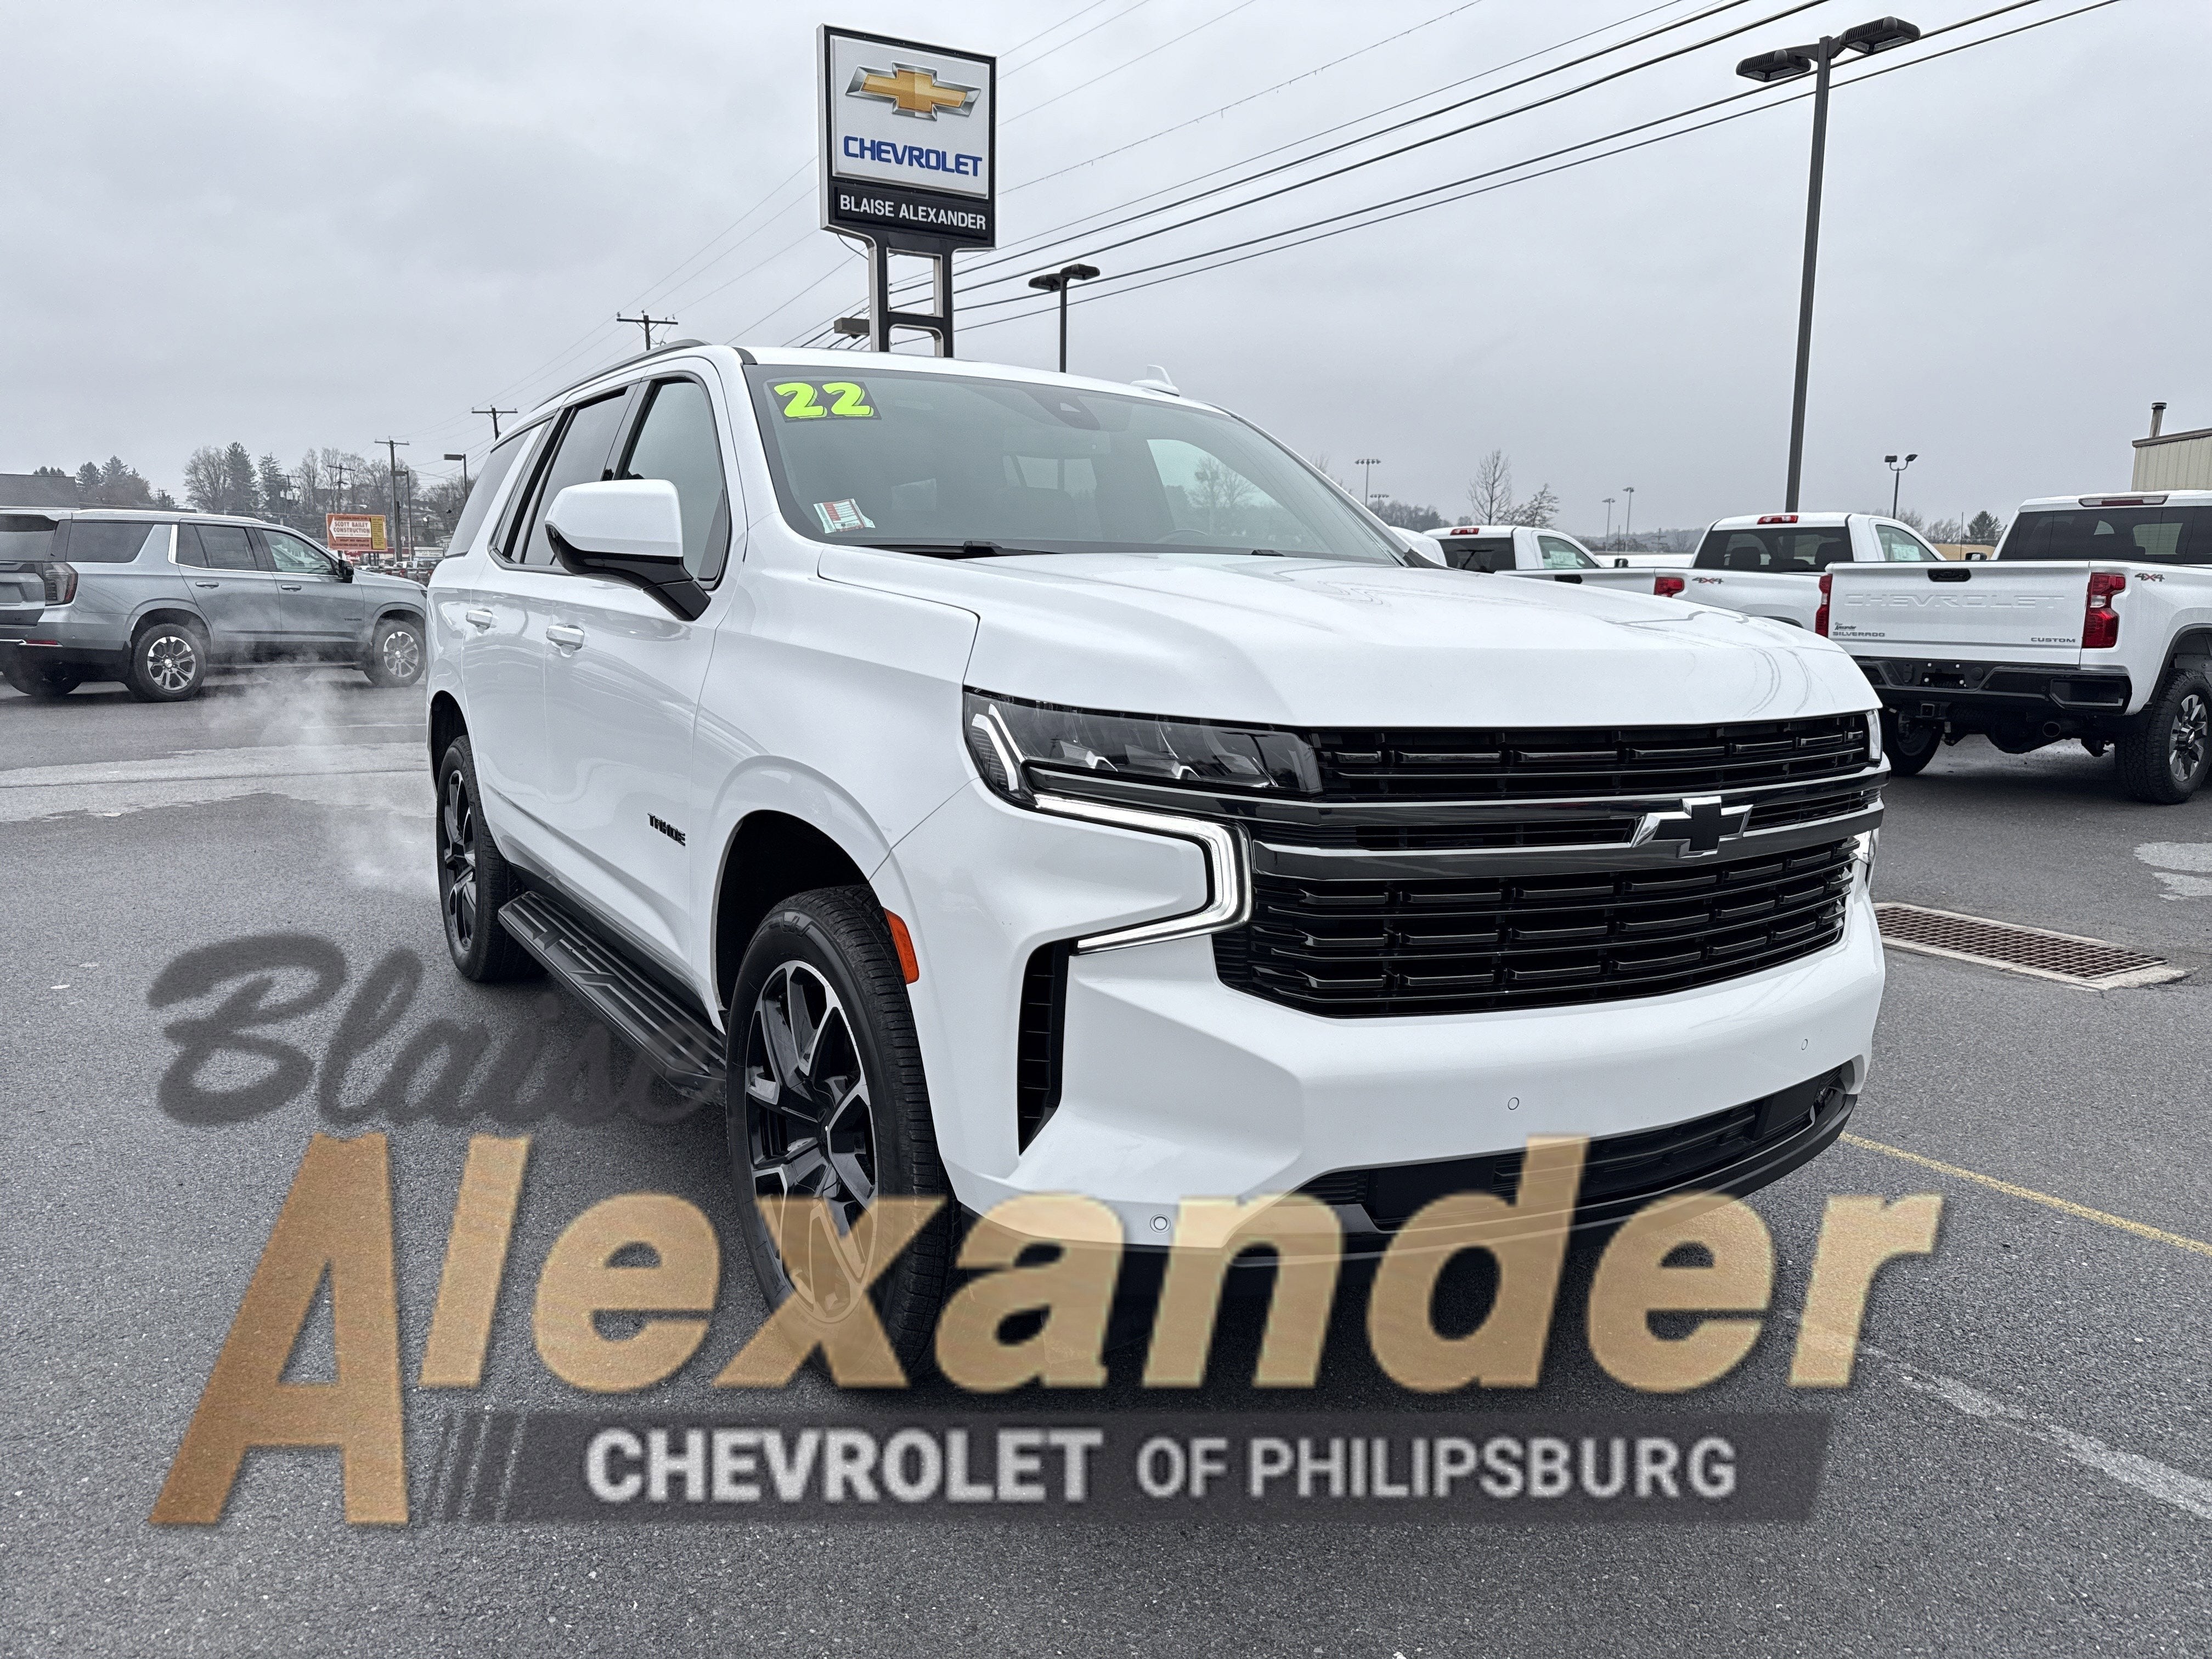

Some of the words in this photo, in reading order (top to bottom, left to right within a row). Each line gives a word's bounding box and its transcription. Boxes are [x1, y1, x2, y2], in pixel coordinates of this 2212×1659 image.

[843, 136, 983, 177] CHEVROLET
[840, 194, 895, 217] BLAISE
[899, 204, 986, 230] ALEXANDER
[774, 382, 874, 418] 22
[1844, 594, 2064, 608] CHEVROLET
[647, 812, 685, 847] TAHOE
